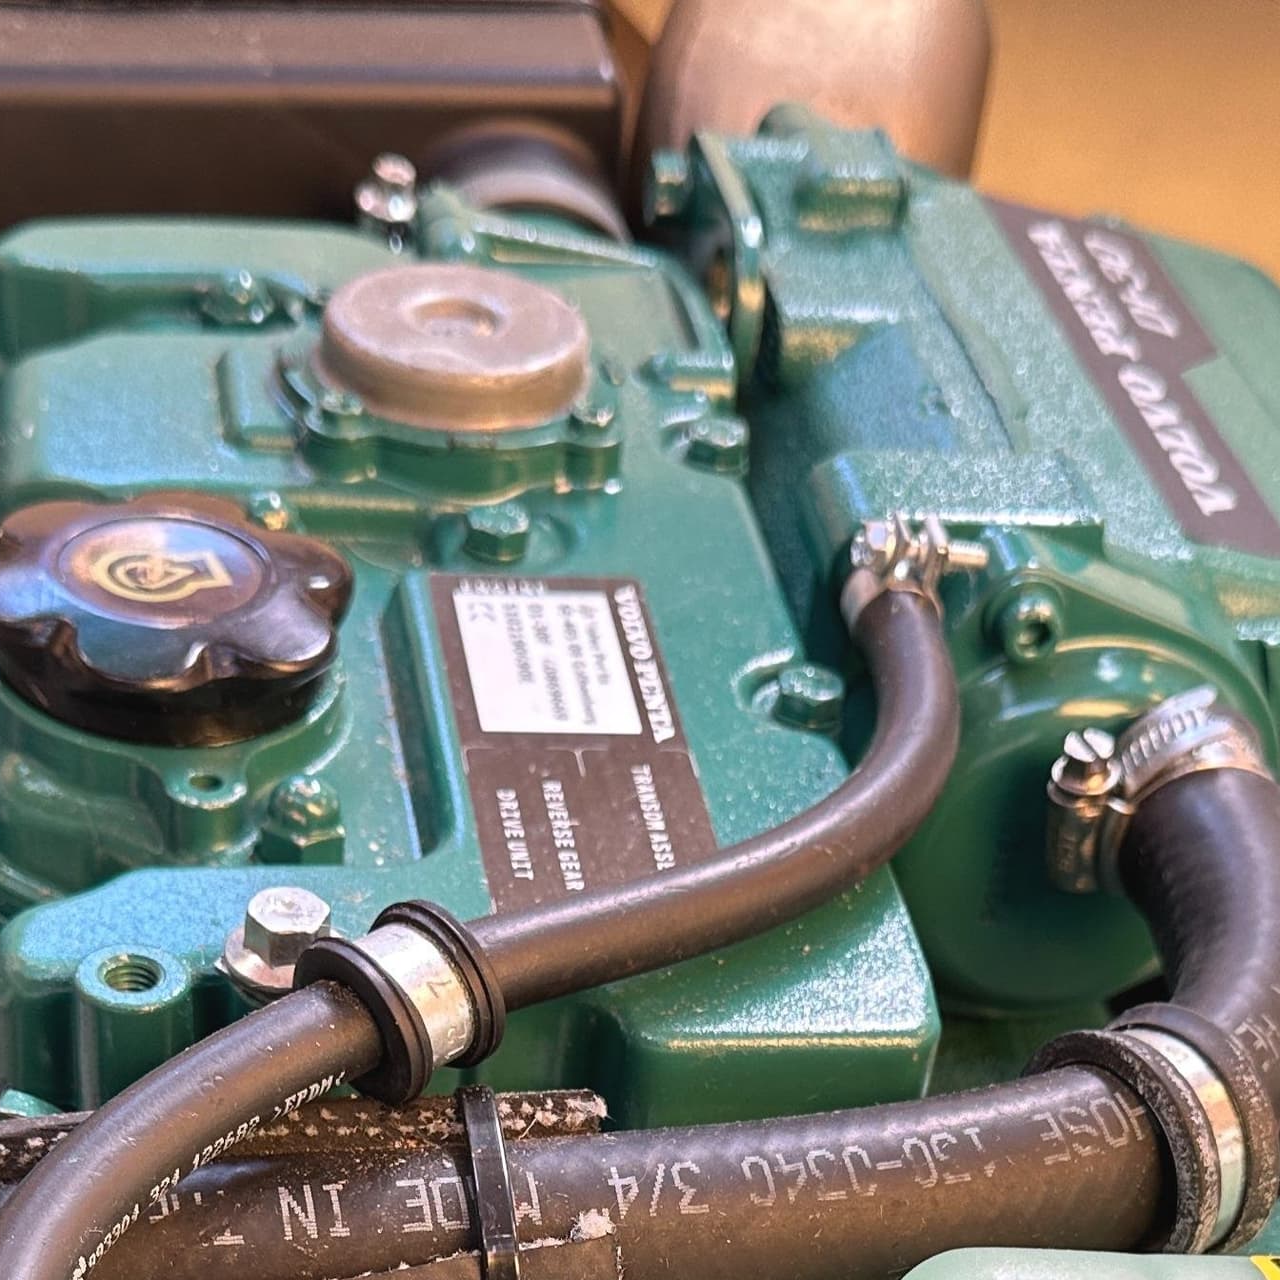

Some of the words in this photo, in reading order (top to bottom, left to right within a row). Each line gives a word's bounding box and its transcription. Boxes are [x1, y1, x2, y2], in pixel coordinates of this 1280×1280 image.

[1027, 221, 1140, 361] PENTA
[1117, 361, 1239, 517] VOLVO
[613, 583, 654, 661] VOLVO
[633, 659, 675, 744] PENTA
[495, 786, 525, 841] DRIVE
[541, 778, 577, 851] REVERSE
[630, 763, 665, 832] TRANSOM
[507, 839, 535, 885] UNIT
[557, 848, 586, 895] GEAR
[279, 1180, 350, 1241] IN
[396, 1171, 543, 1233] MDE
